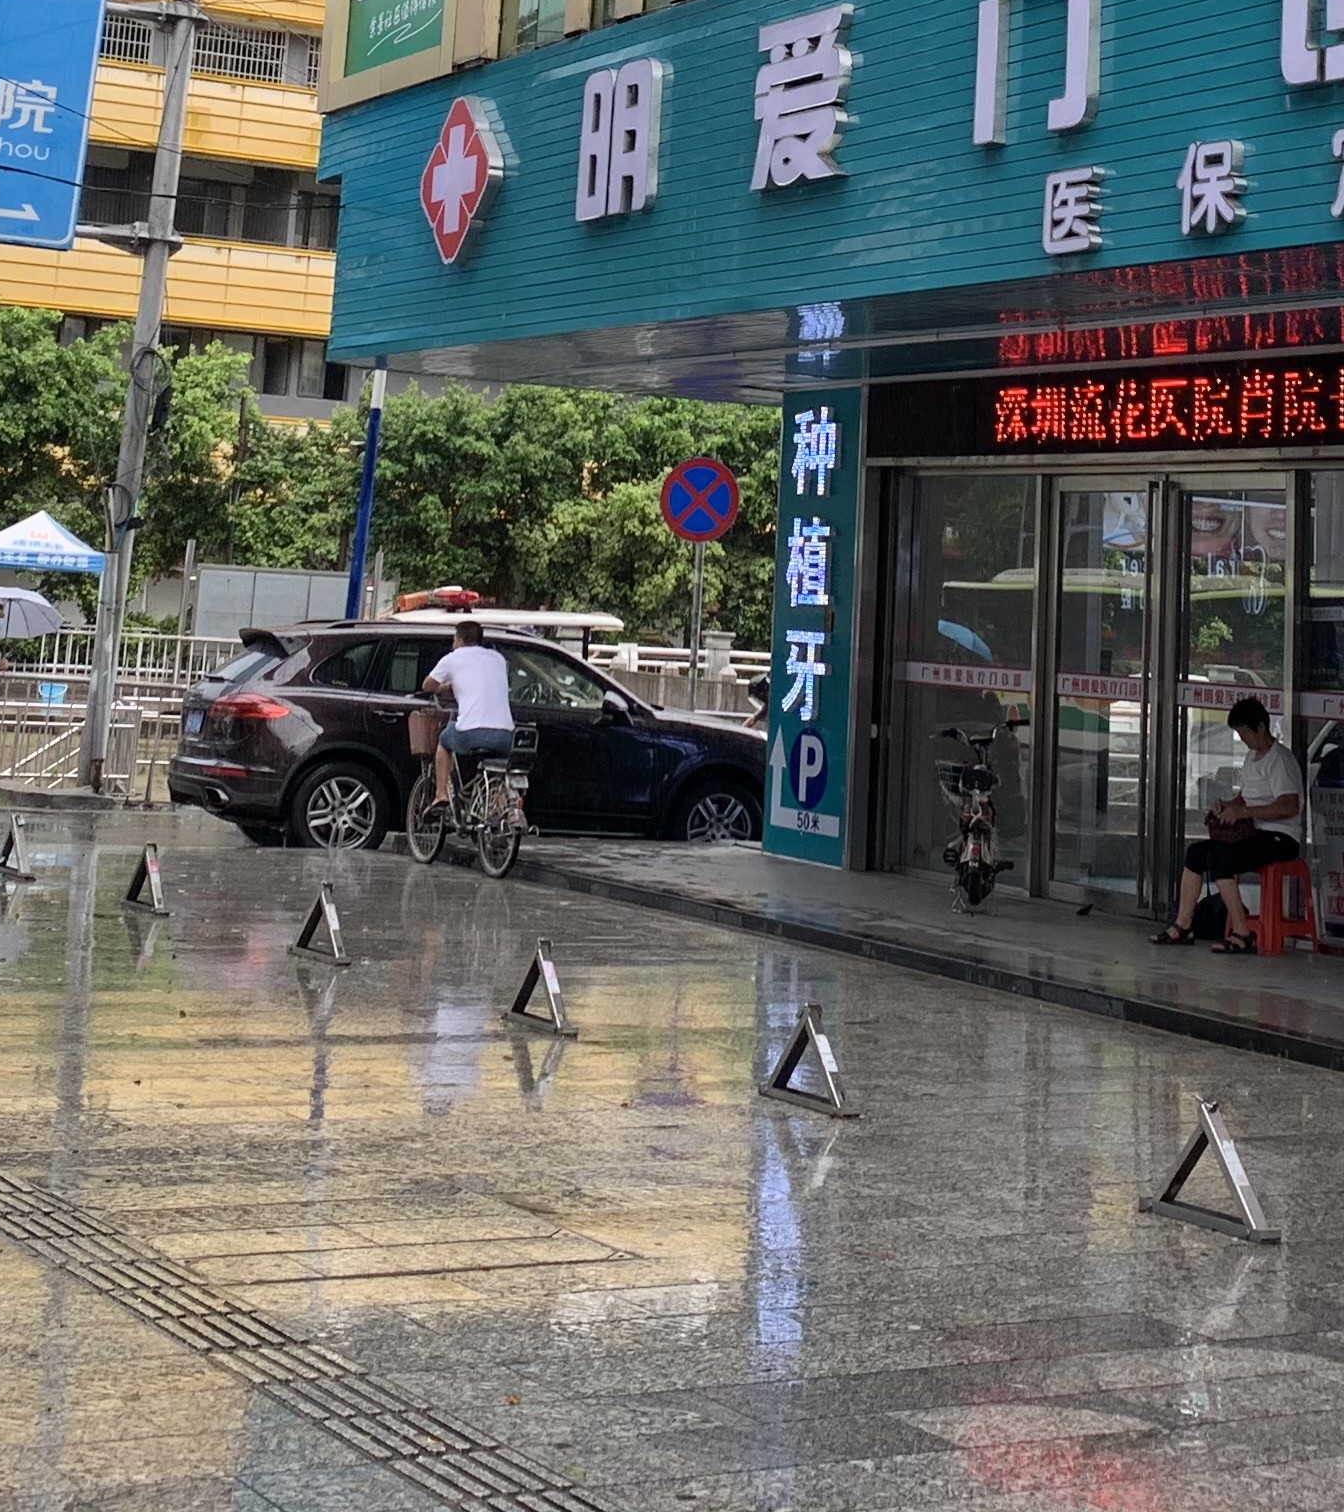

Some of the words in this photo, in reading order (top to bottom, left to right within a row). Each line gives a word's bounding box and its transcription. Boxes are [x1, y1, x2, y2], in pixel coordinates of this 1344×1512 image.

[781, 405, 840, 722] 种植牙
[798, 734, 825, 802] P
[796, 812, 820, 832] 50米
